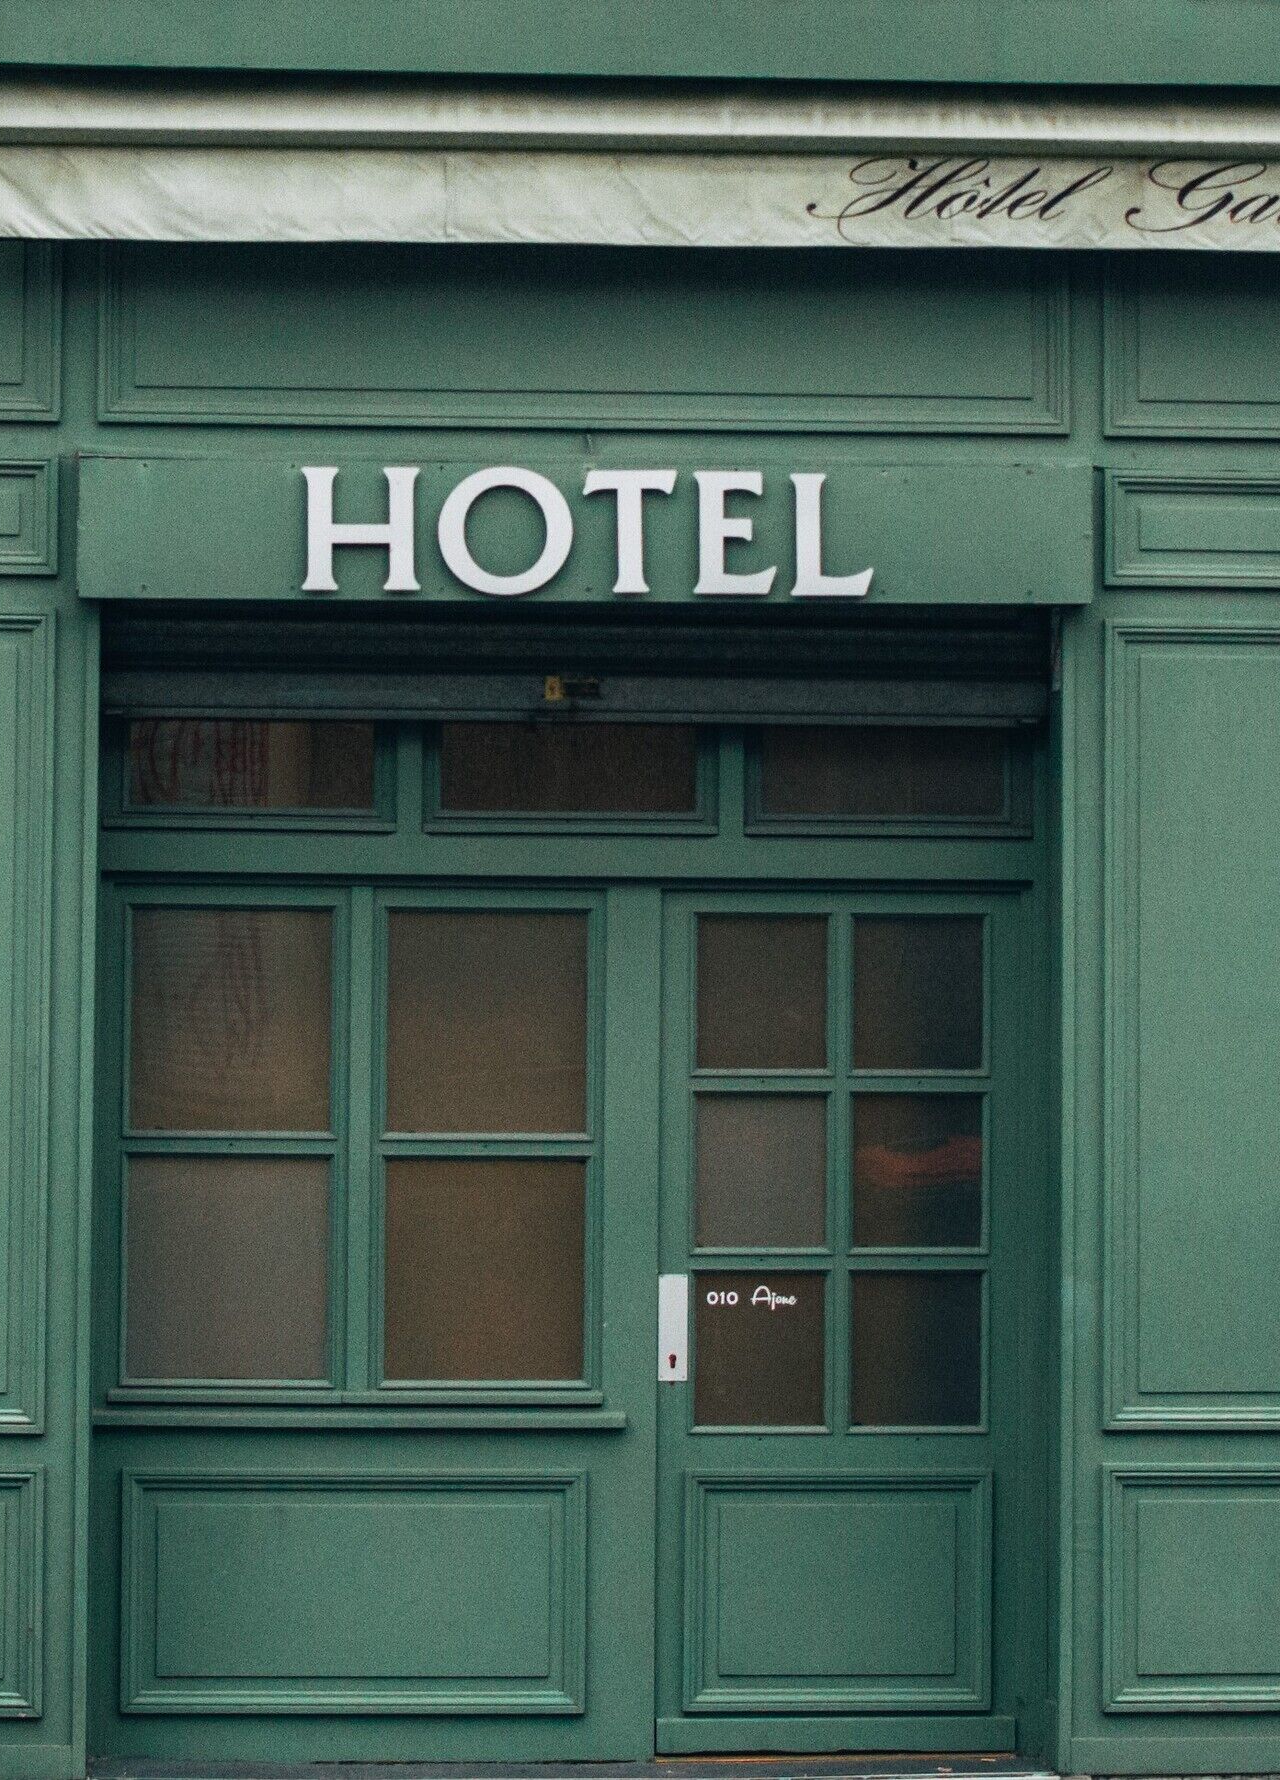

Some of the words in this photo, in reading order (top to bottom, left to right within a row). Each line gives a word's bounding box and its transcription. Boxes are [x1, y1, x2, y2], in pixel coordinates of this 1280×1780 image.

[806, 157, 1113, 246] Hôtel
[301, 466, 874, 596] HOTEL
[706, 1290, 739, 1306] 010
